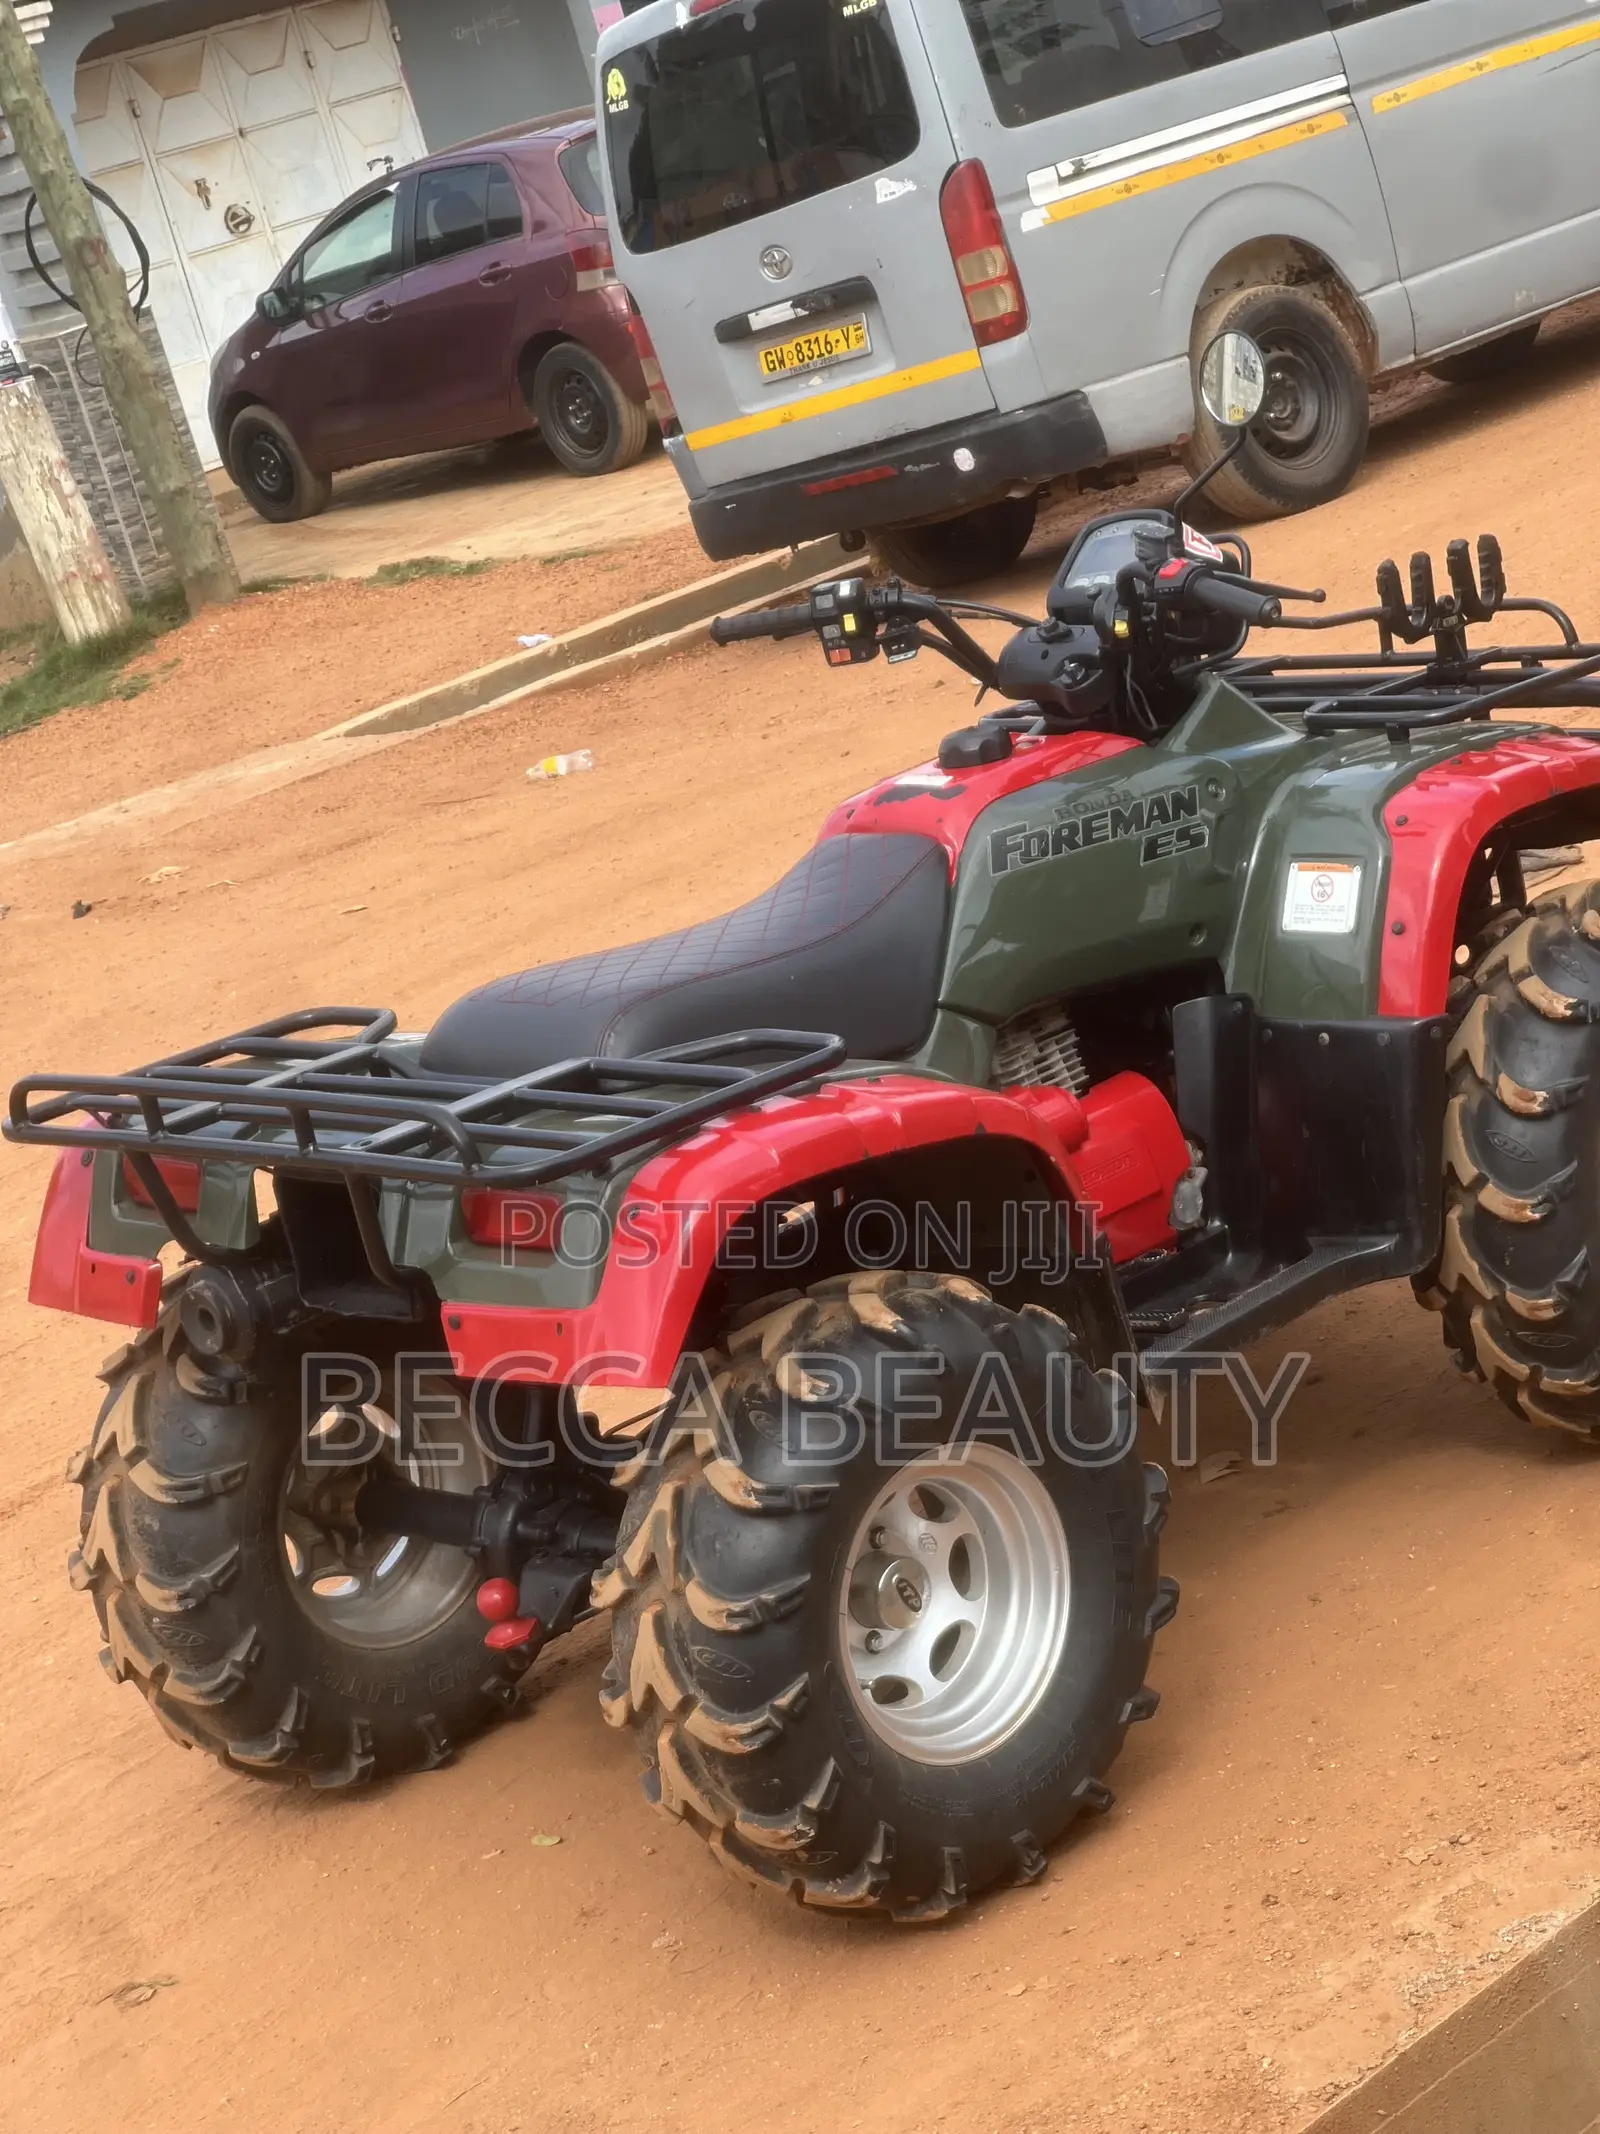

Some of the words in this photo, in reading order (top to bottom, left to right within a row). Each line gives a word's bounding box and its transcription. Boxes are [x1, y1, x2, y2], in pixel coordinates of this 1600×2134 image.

[842, 0, 877, 17] MLGB
[609, 100, 629, 113] MLGB
[789, 363, 811, 375] THANK
[819, 355, 840, 366] JESUS
[1053, 787, 1136, 822] HONDA
[988, 785, 1199, 877] FOREMAN
[1140, 823, 1209, 867] ES
